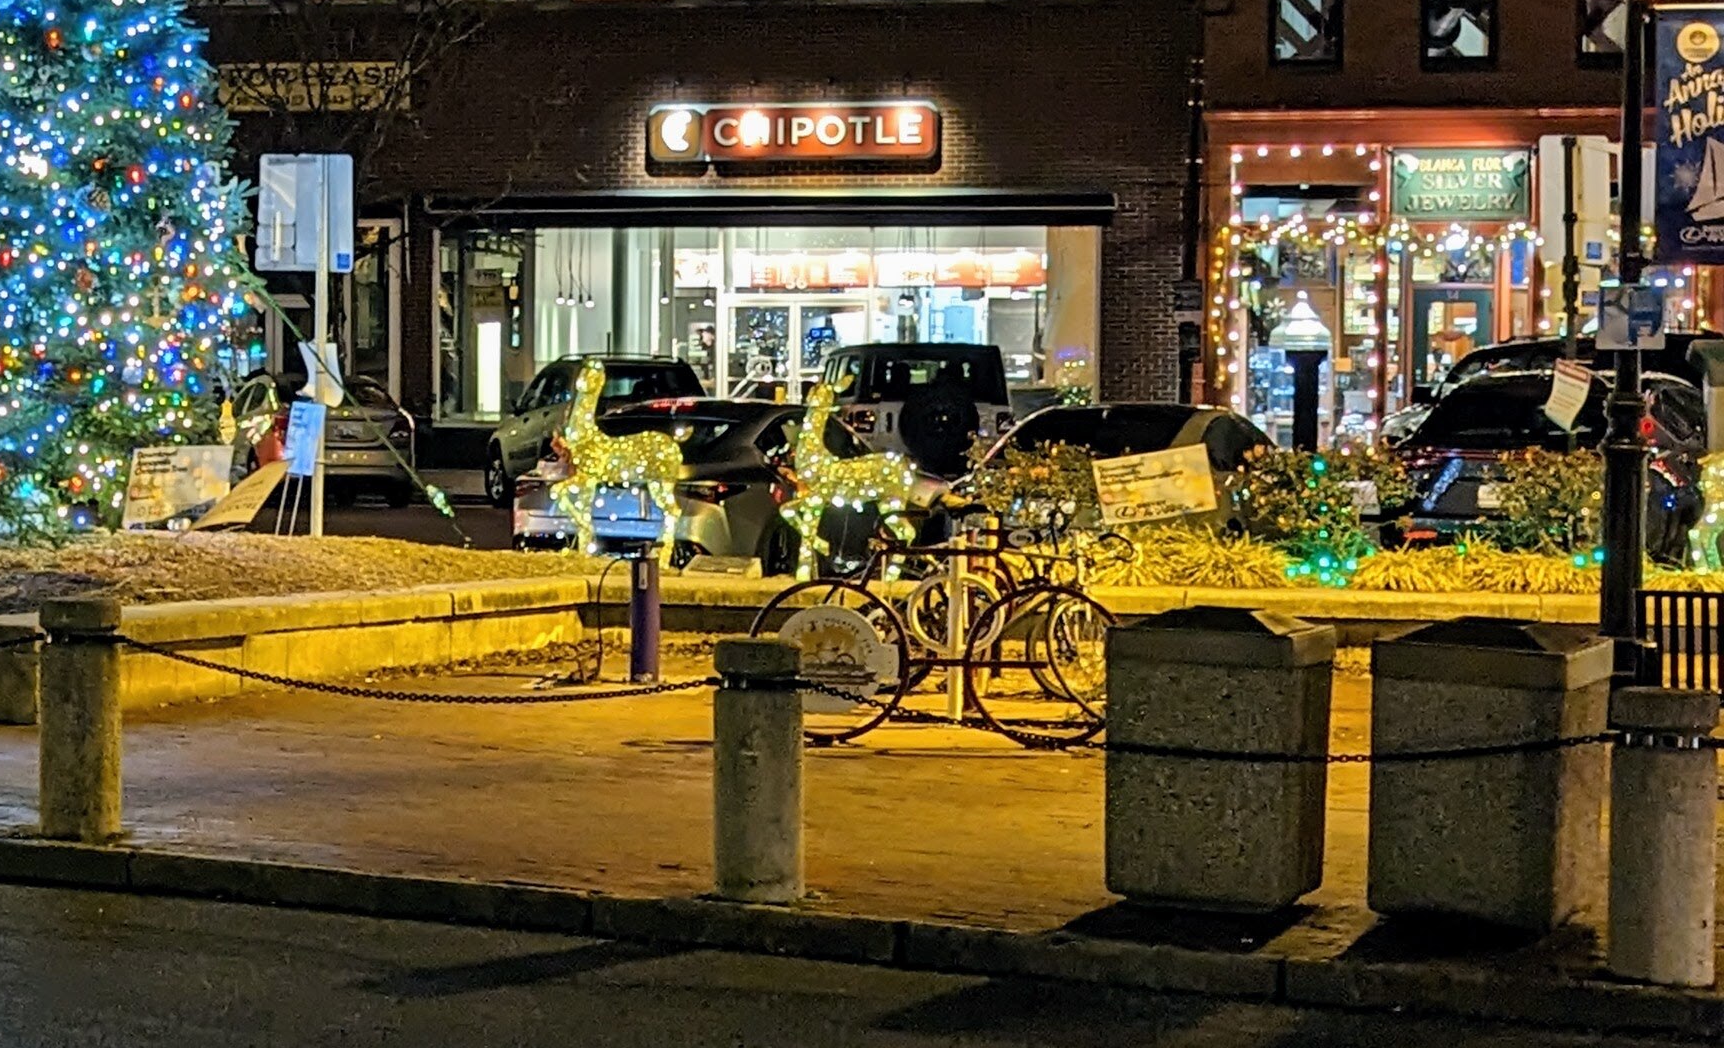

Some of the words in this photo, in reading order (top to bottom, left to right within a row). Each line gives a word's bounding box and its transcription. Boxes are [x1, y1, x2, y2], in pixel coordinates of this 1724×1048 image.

[713, 112, 924, 147] CHIPOTLE
[1471, 157, 1503, 171] FLOR
[1422, 173, 1504, 190] SILVER
[1405, 193, 1518, 212] JEWELRY
